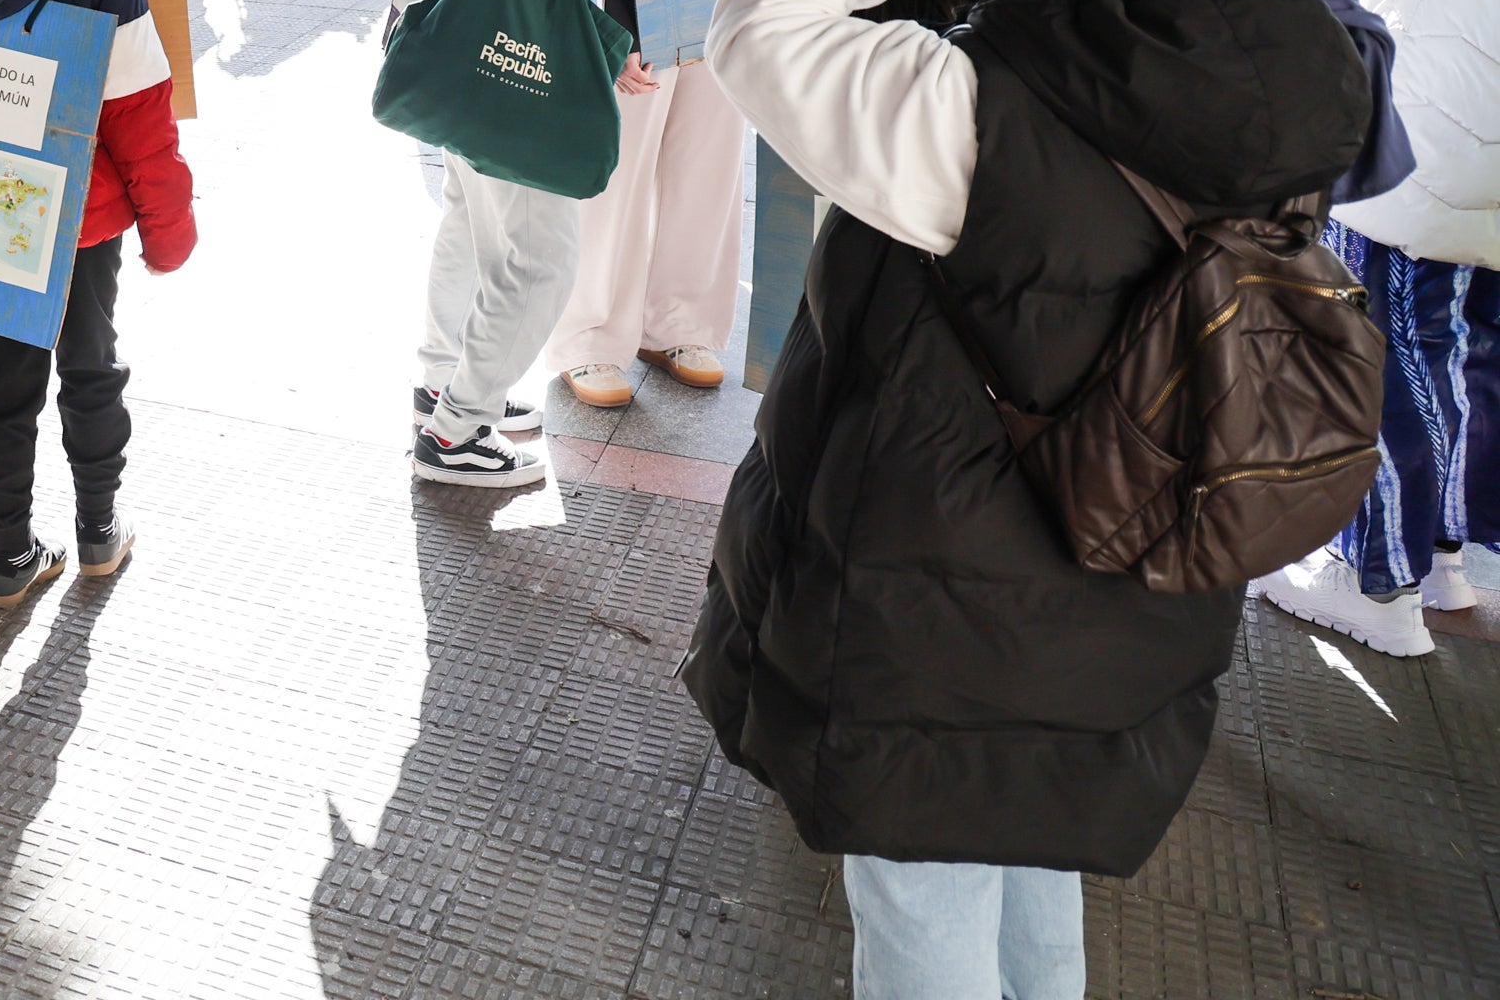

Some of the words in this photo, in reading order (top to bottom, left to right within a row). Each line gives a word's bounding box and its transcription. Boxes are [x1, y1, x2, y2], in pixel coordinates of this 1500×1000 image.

[493, 30, 547, 65] Pacific
[20, 72, 35, 87] LA
[479, 44, 552, 84] Republic
[476, 67, 496, 79] TEEN
[499, 76, 549, 97] DEPARTMENT
